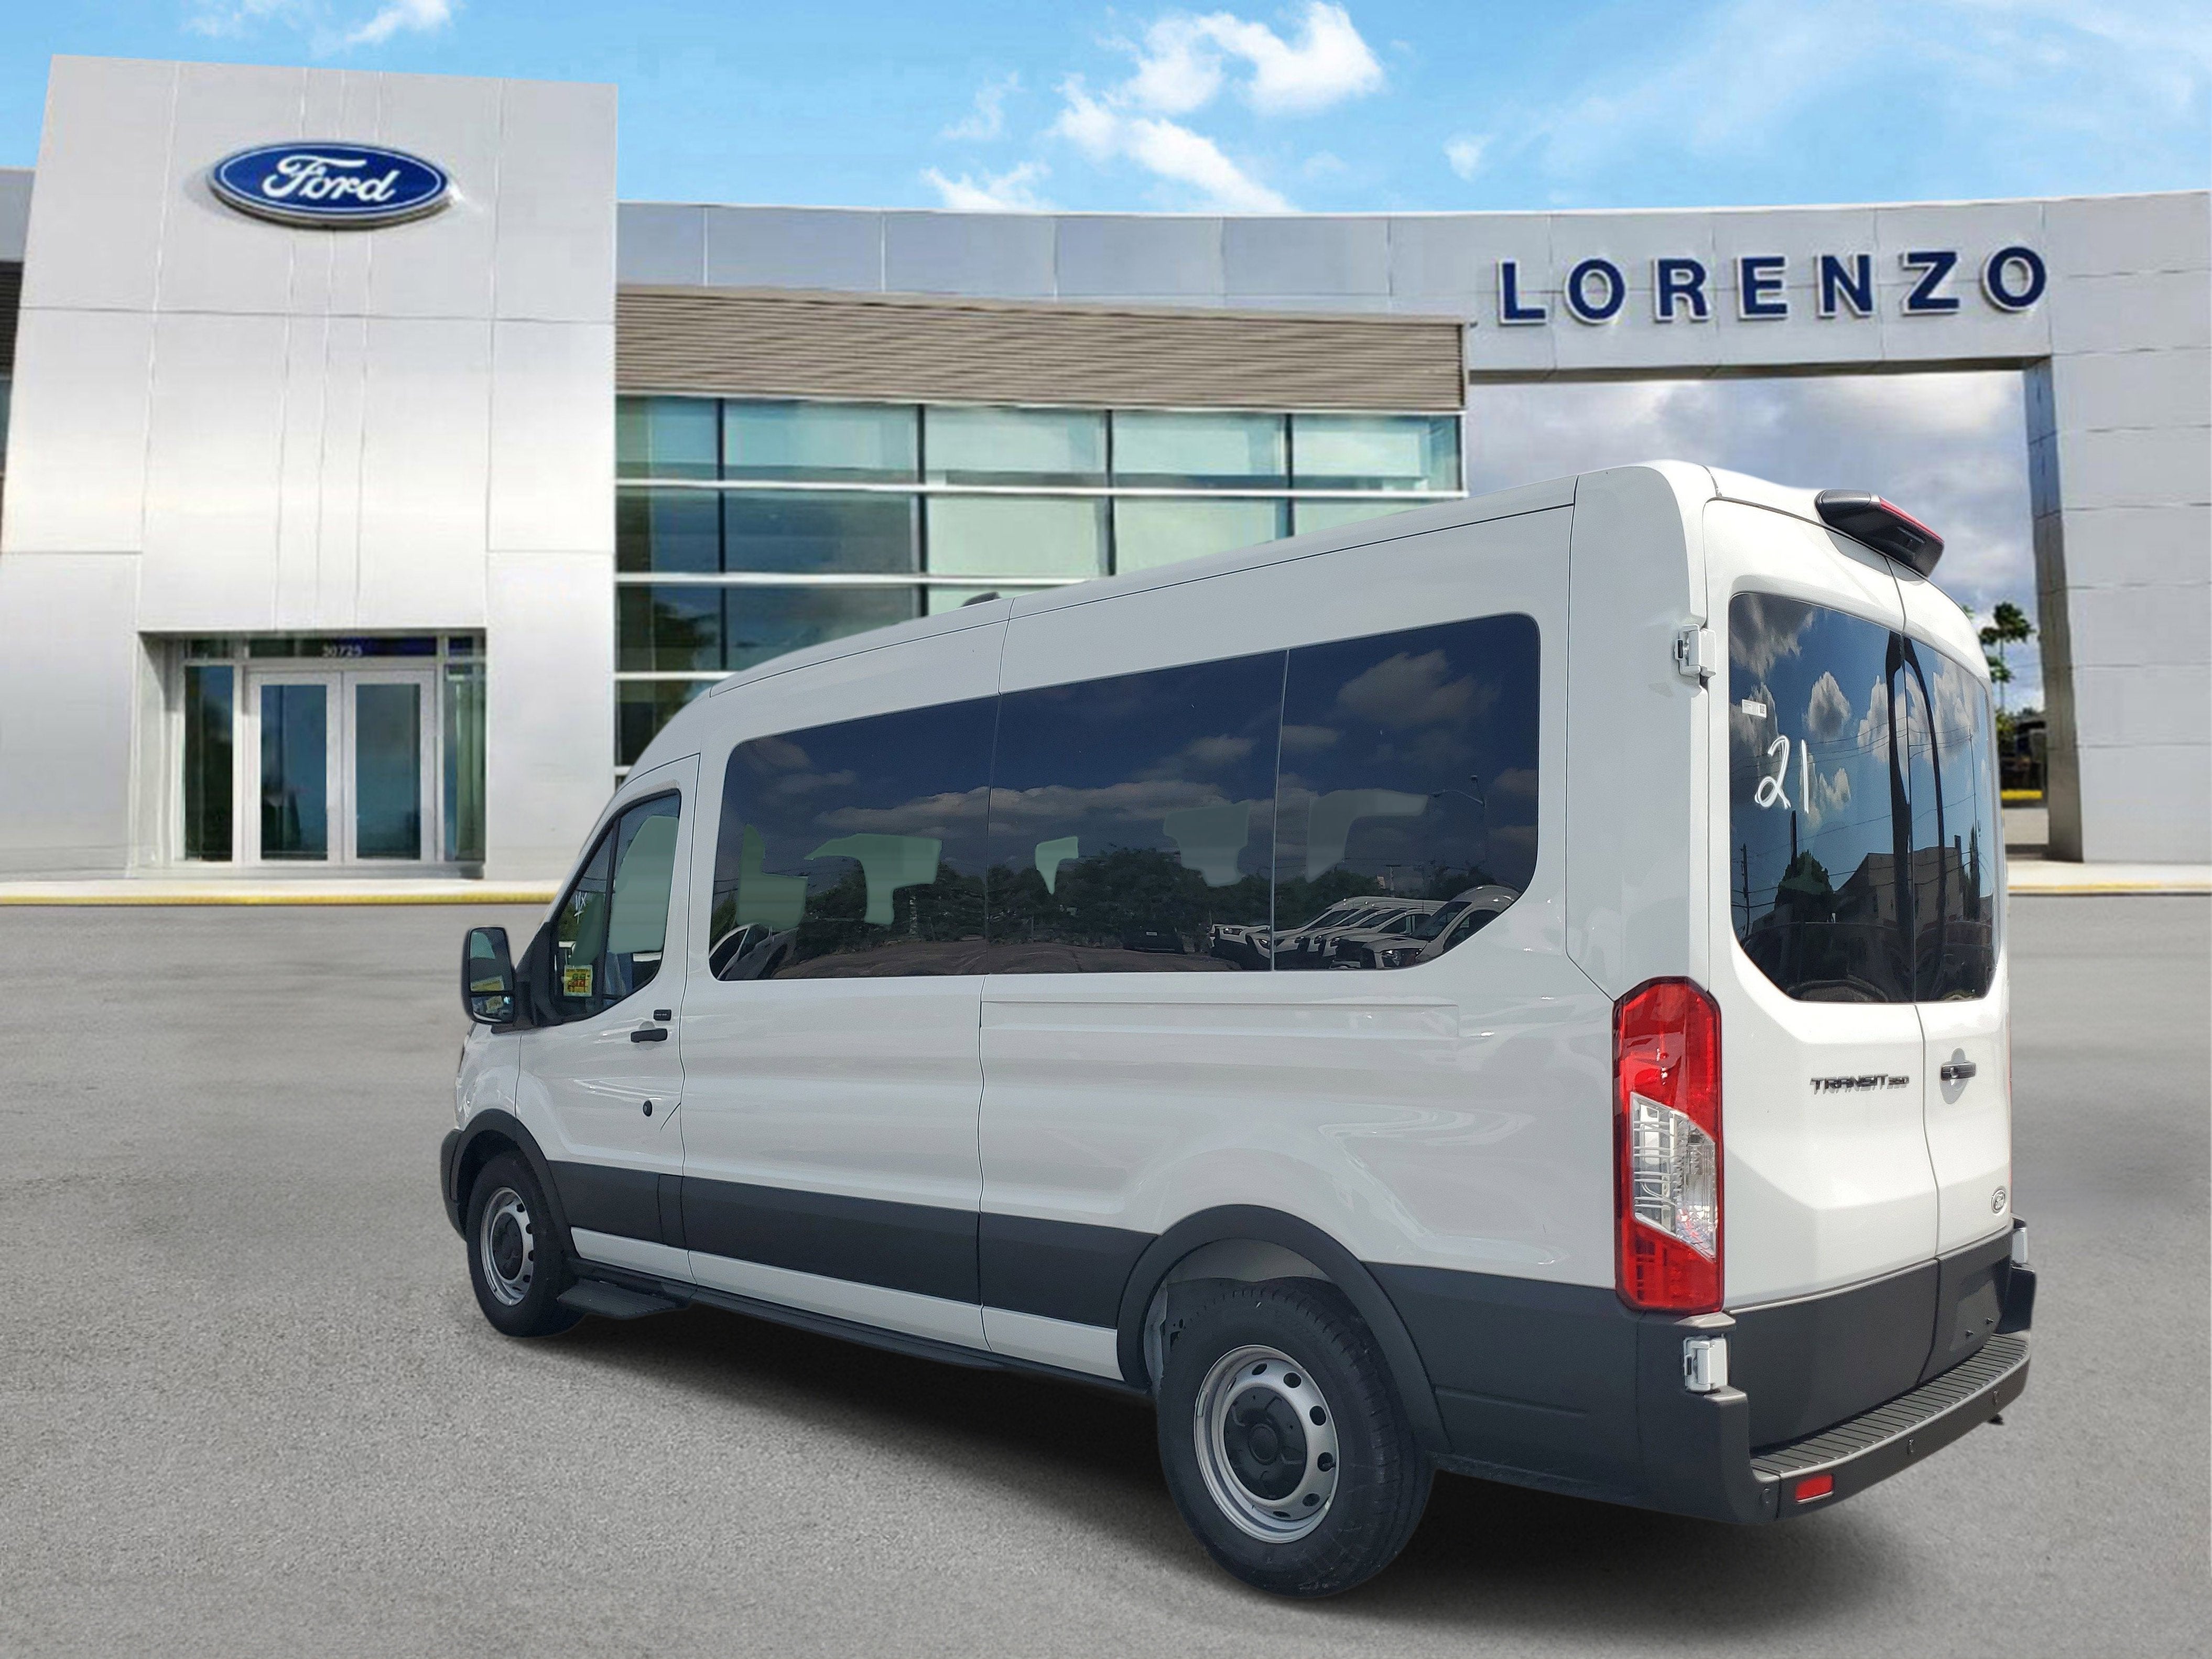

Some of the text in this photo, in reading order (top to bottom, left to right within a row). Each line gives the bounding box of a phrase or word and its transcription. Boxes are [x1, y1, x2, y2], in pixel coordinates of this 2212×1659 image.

[263, 155, 401, 202] Ford
[1499, 246, 2046, 321] LORENZO
[1754, 734, 1809, 814] 21
[1811, 1074, 1888, 1091] TRANSIT
